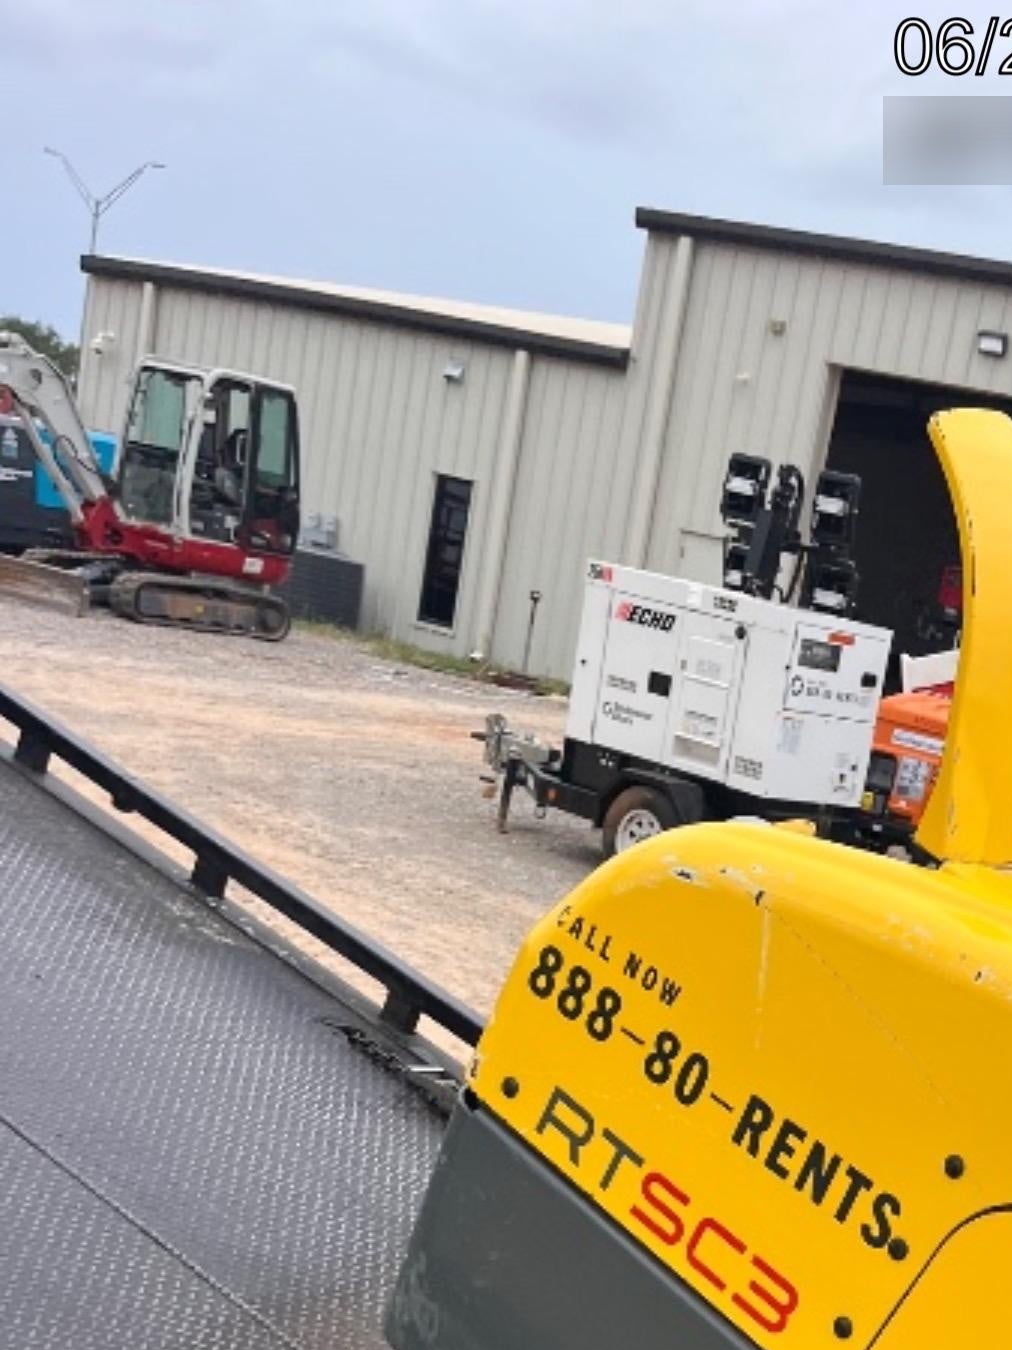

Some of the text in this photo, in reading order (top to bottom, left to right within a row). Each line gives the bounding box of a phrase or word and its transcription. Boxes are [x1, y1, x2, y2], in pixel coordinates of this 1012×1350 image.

[625, 604, 677, 634] ECHO
[623, 950, 682, 1008] NOW
[535, 1085, 800, 1334] RTSC3
